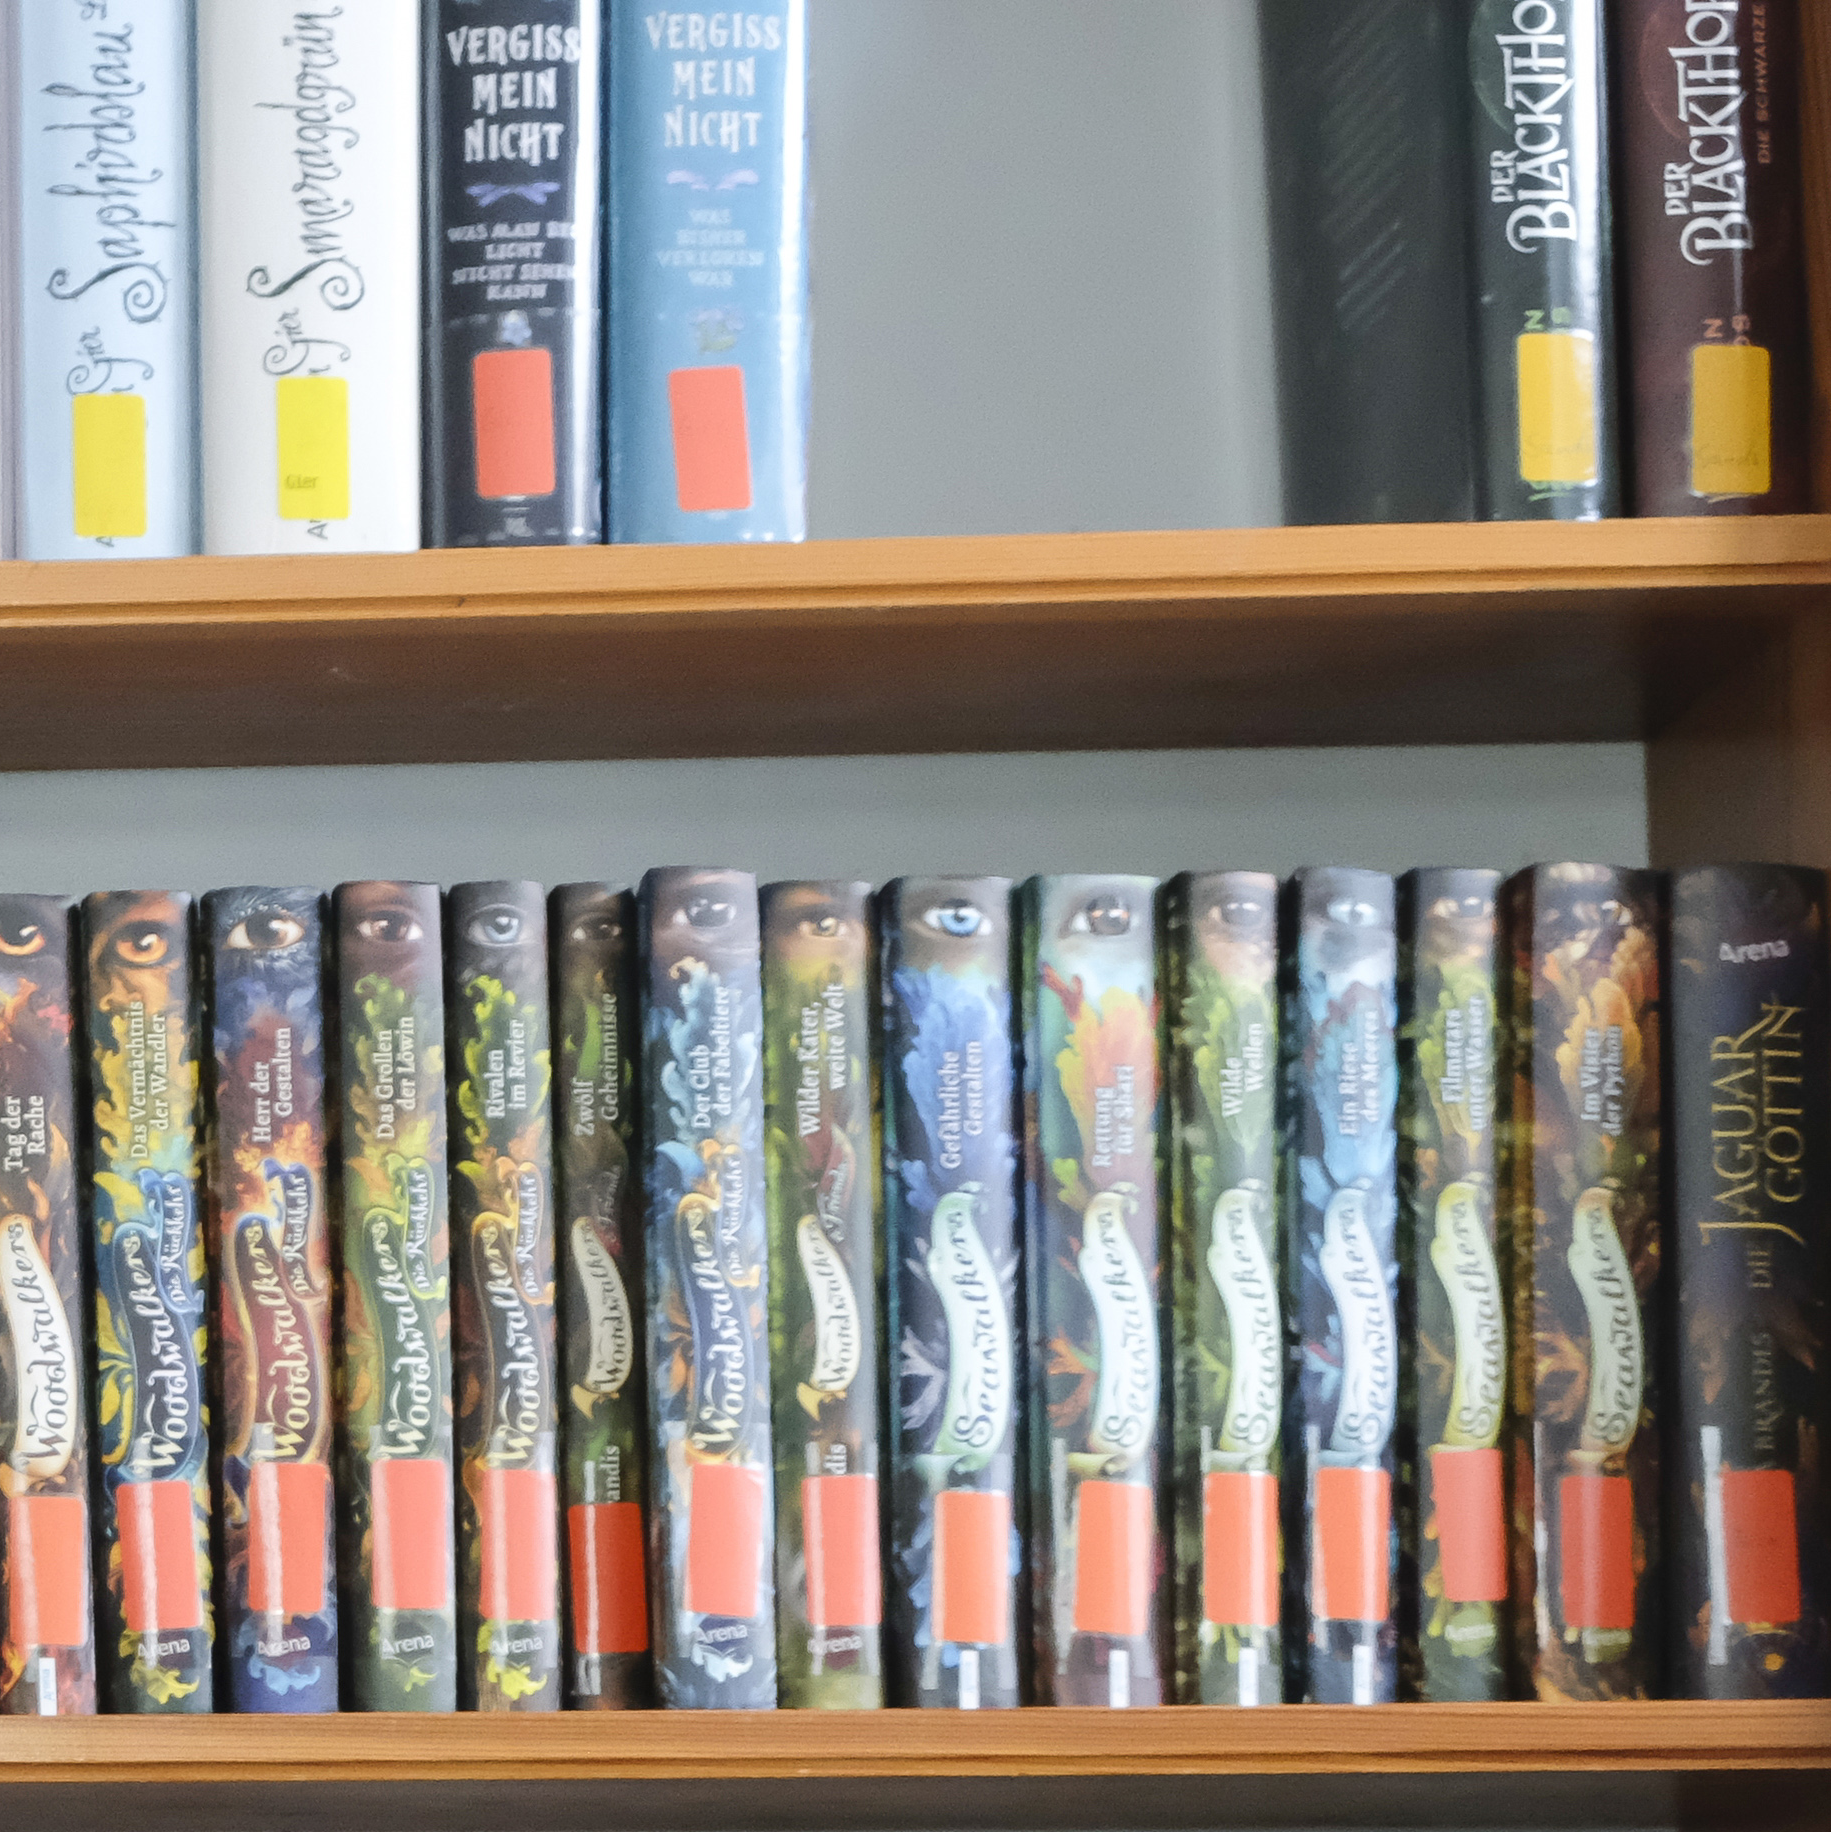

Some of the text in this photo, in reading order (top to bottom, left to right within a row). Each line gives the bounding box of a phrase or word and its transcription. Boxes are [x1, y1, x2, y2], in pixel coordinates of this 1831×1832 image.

[446, 25, 582, 66] VERGISS
[646, 11, 782, 52] VERGISS
[472, 70, 557, 116] MEIN
[672, 58, 757, 100] MEIN
[464, 122, 564, 167] NICHT
[664, 107, 763, 153] NICHT
[1494, 0, 1578, 253] BLACKTHO
[1668, 0, 1753, 266] BLACKTHO
[1490, 149, 1517, 203] DER
[1664, 162, 1691, 215] DER
[596, 992, 622, 1122] Geheimnisse
[821, 982, 847, 1090] weite Welt
[797, 1000, 827, 1136] Wilder Kater,
[1, 1095, 29, 1171] Tag der
[23, 1095, 47, 1155] Rache
[572, 1077, 598, 1137] Zwölf
[935, 1050, 965, 1169] Gefährliche
[1696, 1019, 1807, 1248] JAGUAR
